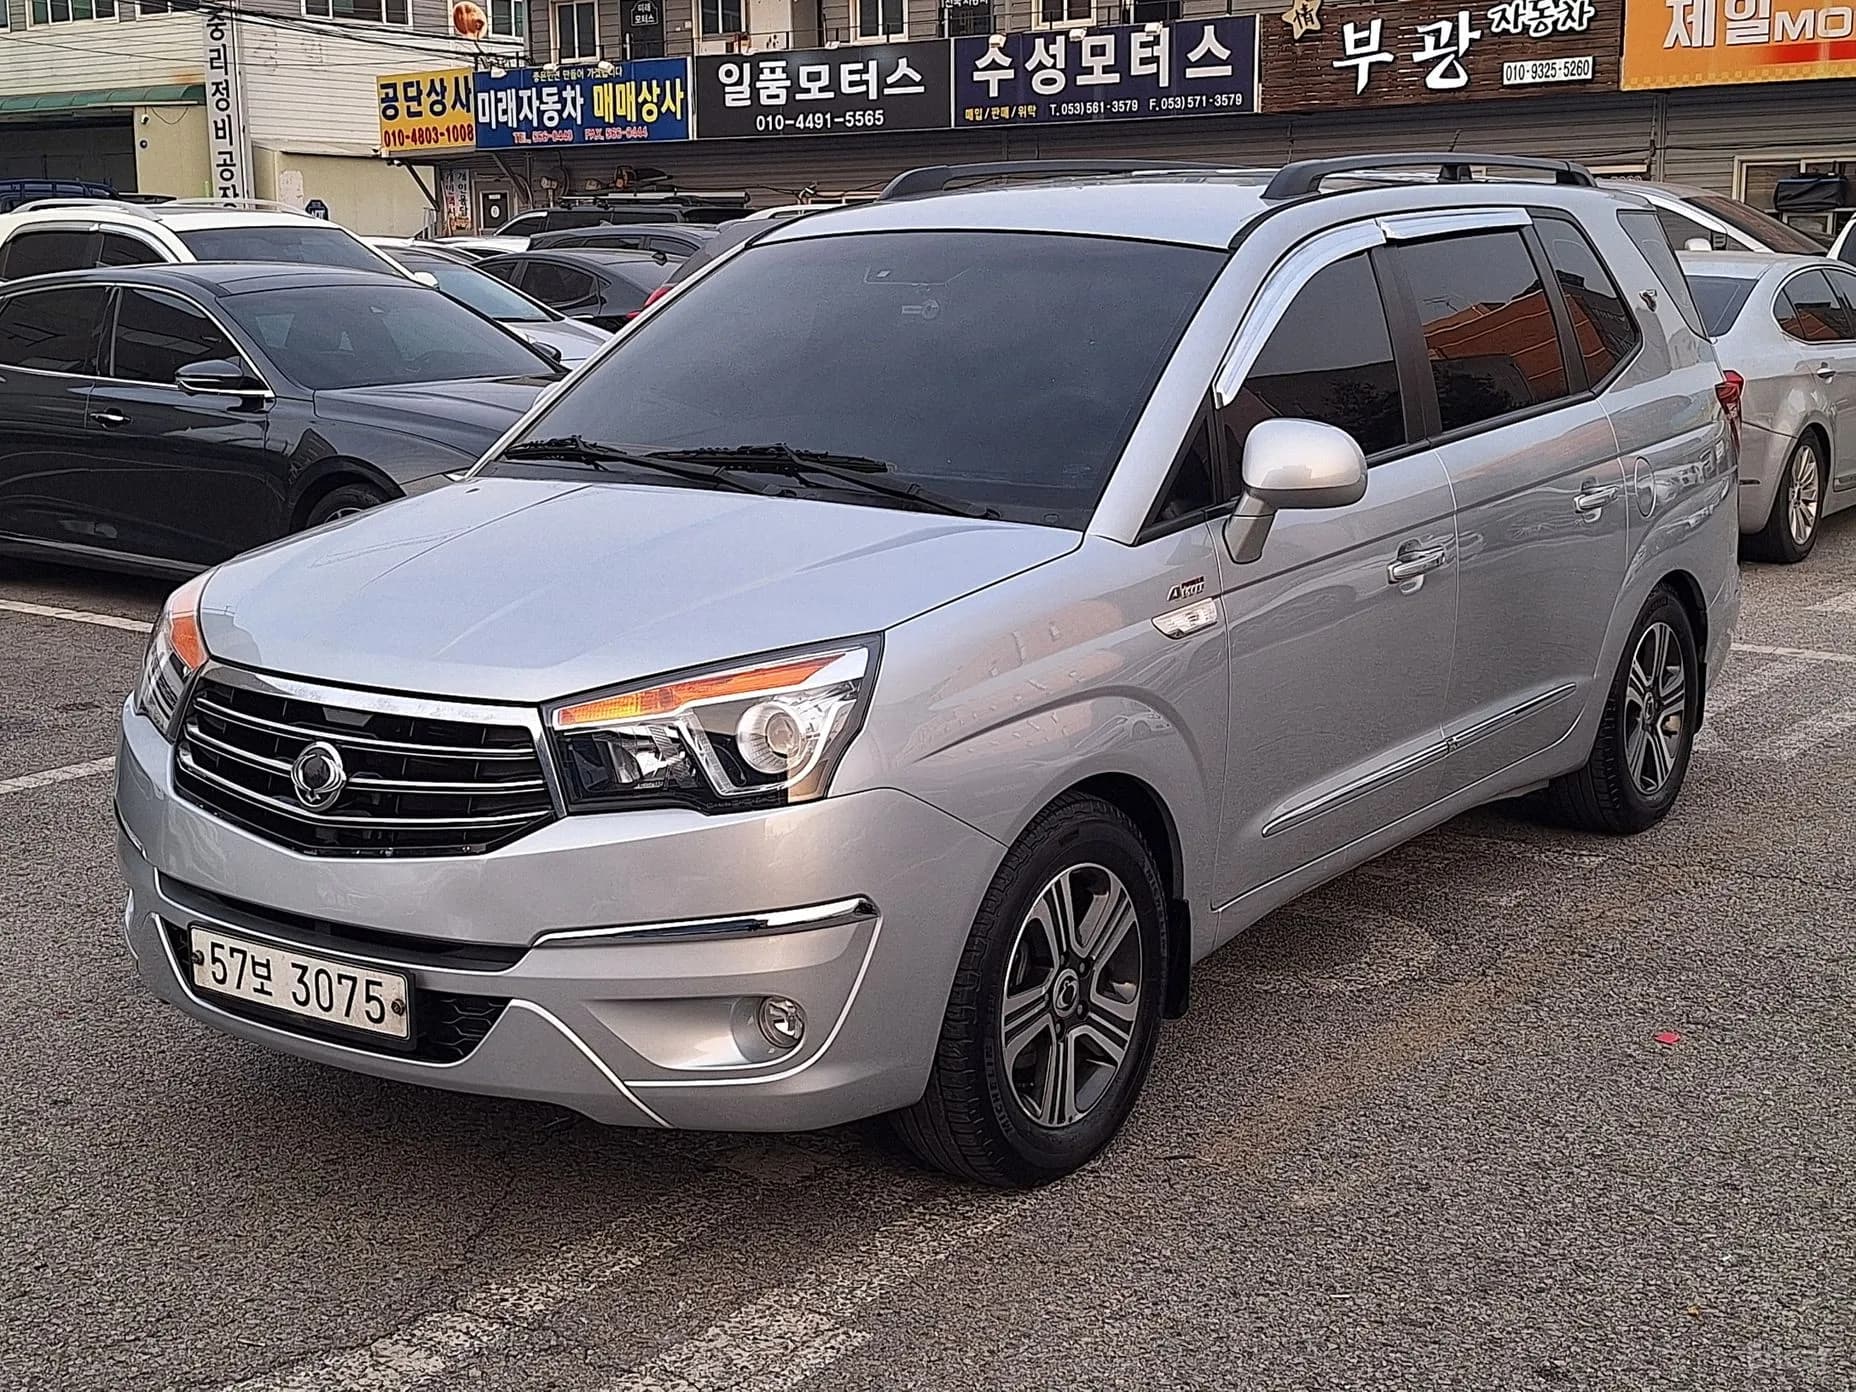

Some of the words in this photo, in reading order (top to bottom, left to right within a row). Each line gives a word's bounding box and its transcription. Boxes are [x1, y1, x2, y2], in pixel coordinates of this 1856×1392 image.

[1488, 0, 1595, 37] 자동차
[718, 57, 925, 107] 일품모터스
[973, 25, 1233, 97] 수성모터스
[1505, 59, 1590, 82] 010-9325-5260
[379, 75, 473, 122] 공단상사
[477, 84, 584, 129] 미래자동차
[593, 79, 684, 123] 매매상사
[756, 109, 884, 131] 010-4491-5565
[384, 123, 474, 147] 010-4803-1008
[210, 941, 273, 996] 57보
[290, 962, 386, 1024] 3075
